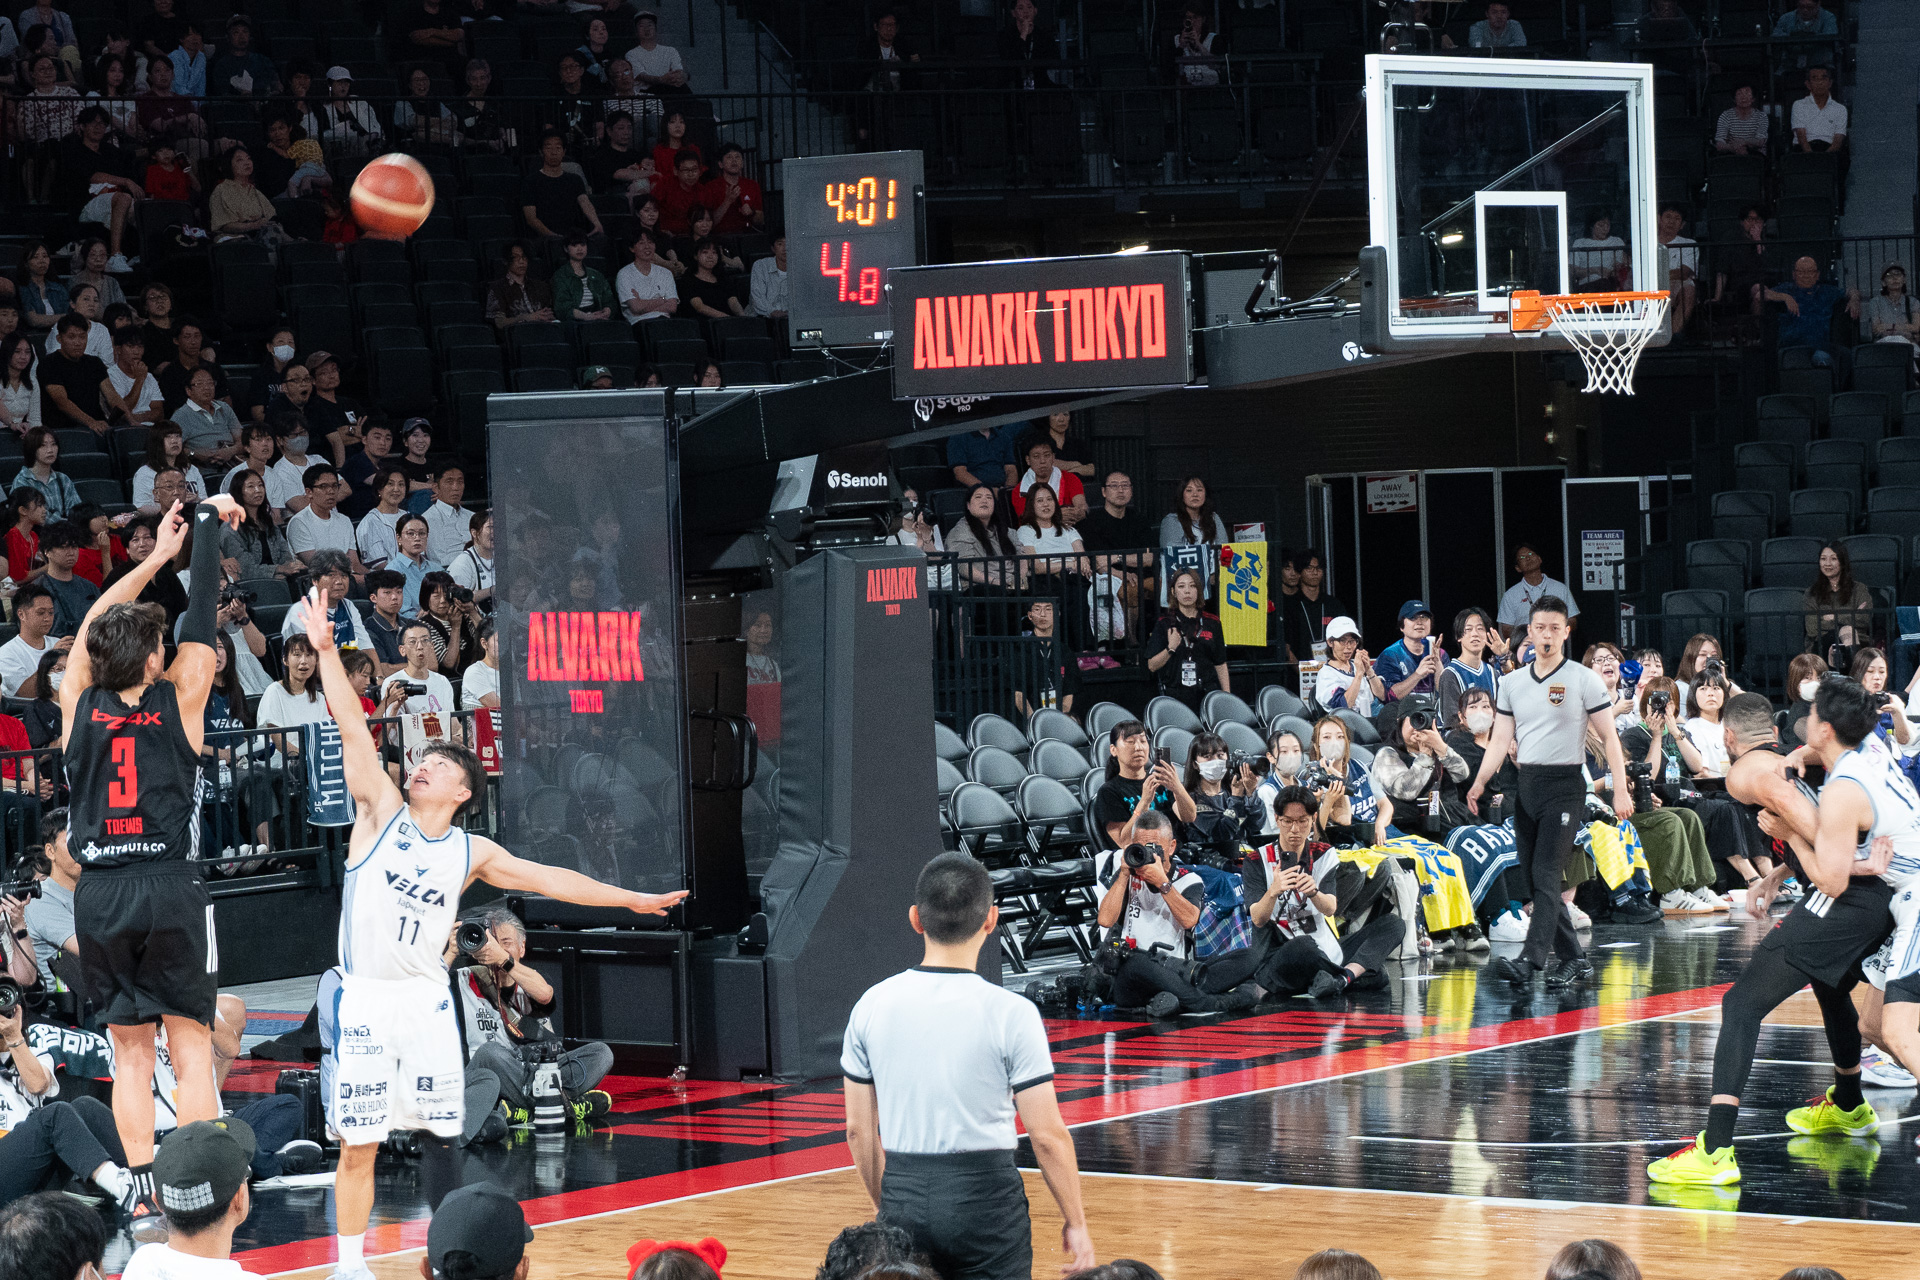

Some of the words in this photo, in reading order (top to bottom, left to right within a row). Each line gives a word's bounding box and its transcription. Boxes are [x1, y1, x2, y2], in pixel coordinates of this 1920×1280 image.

[826, 177, 897, 226] 4:01
[820, 241, 880, 305] 4.8
[914, 291, 1042, 370] ALVARK
[1046, 284, 1167, 362] TOKYO
[937, 395, 991, 409] S-GO
[957, 404, 971, 413] PRO
[841, 472, 888, 487] Senoh
[866, 567, 917, 602] ALVARK
[527, 611, 645, 681] ALVARK
[109, 737, 138, 808] 3
[105, 817, 143, 835] TOEWS
[385, 869, 445, 907] VELCA
[398, 916, 420, 946] 11
[477, 1020, 499, 1032] 004
[360, 1115, 388, 1127] エレナ
